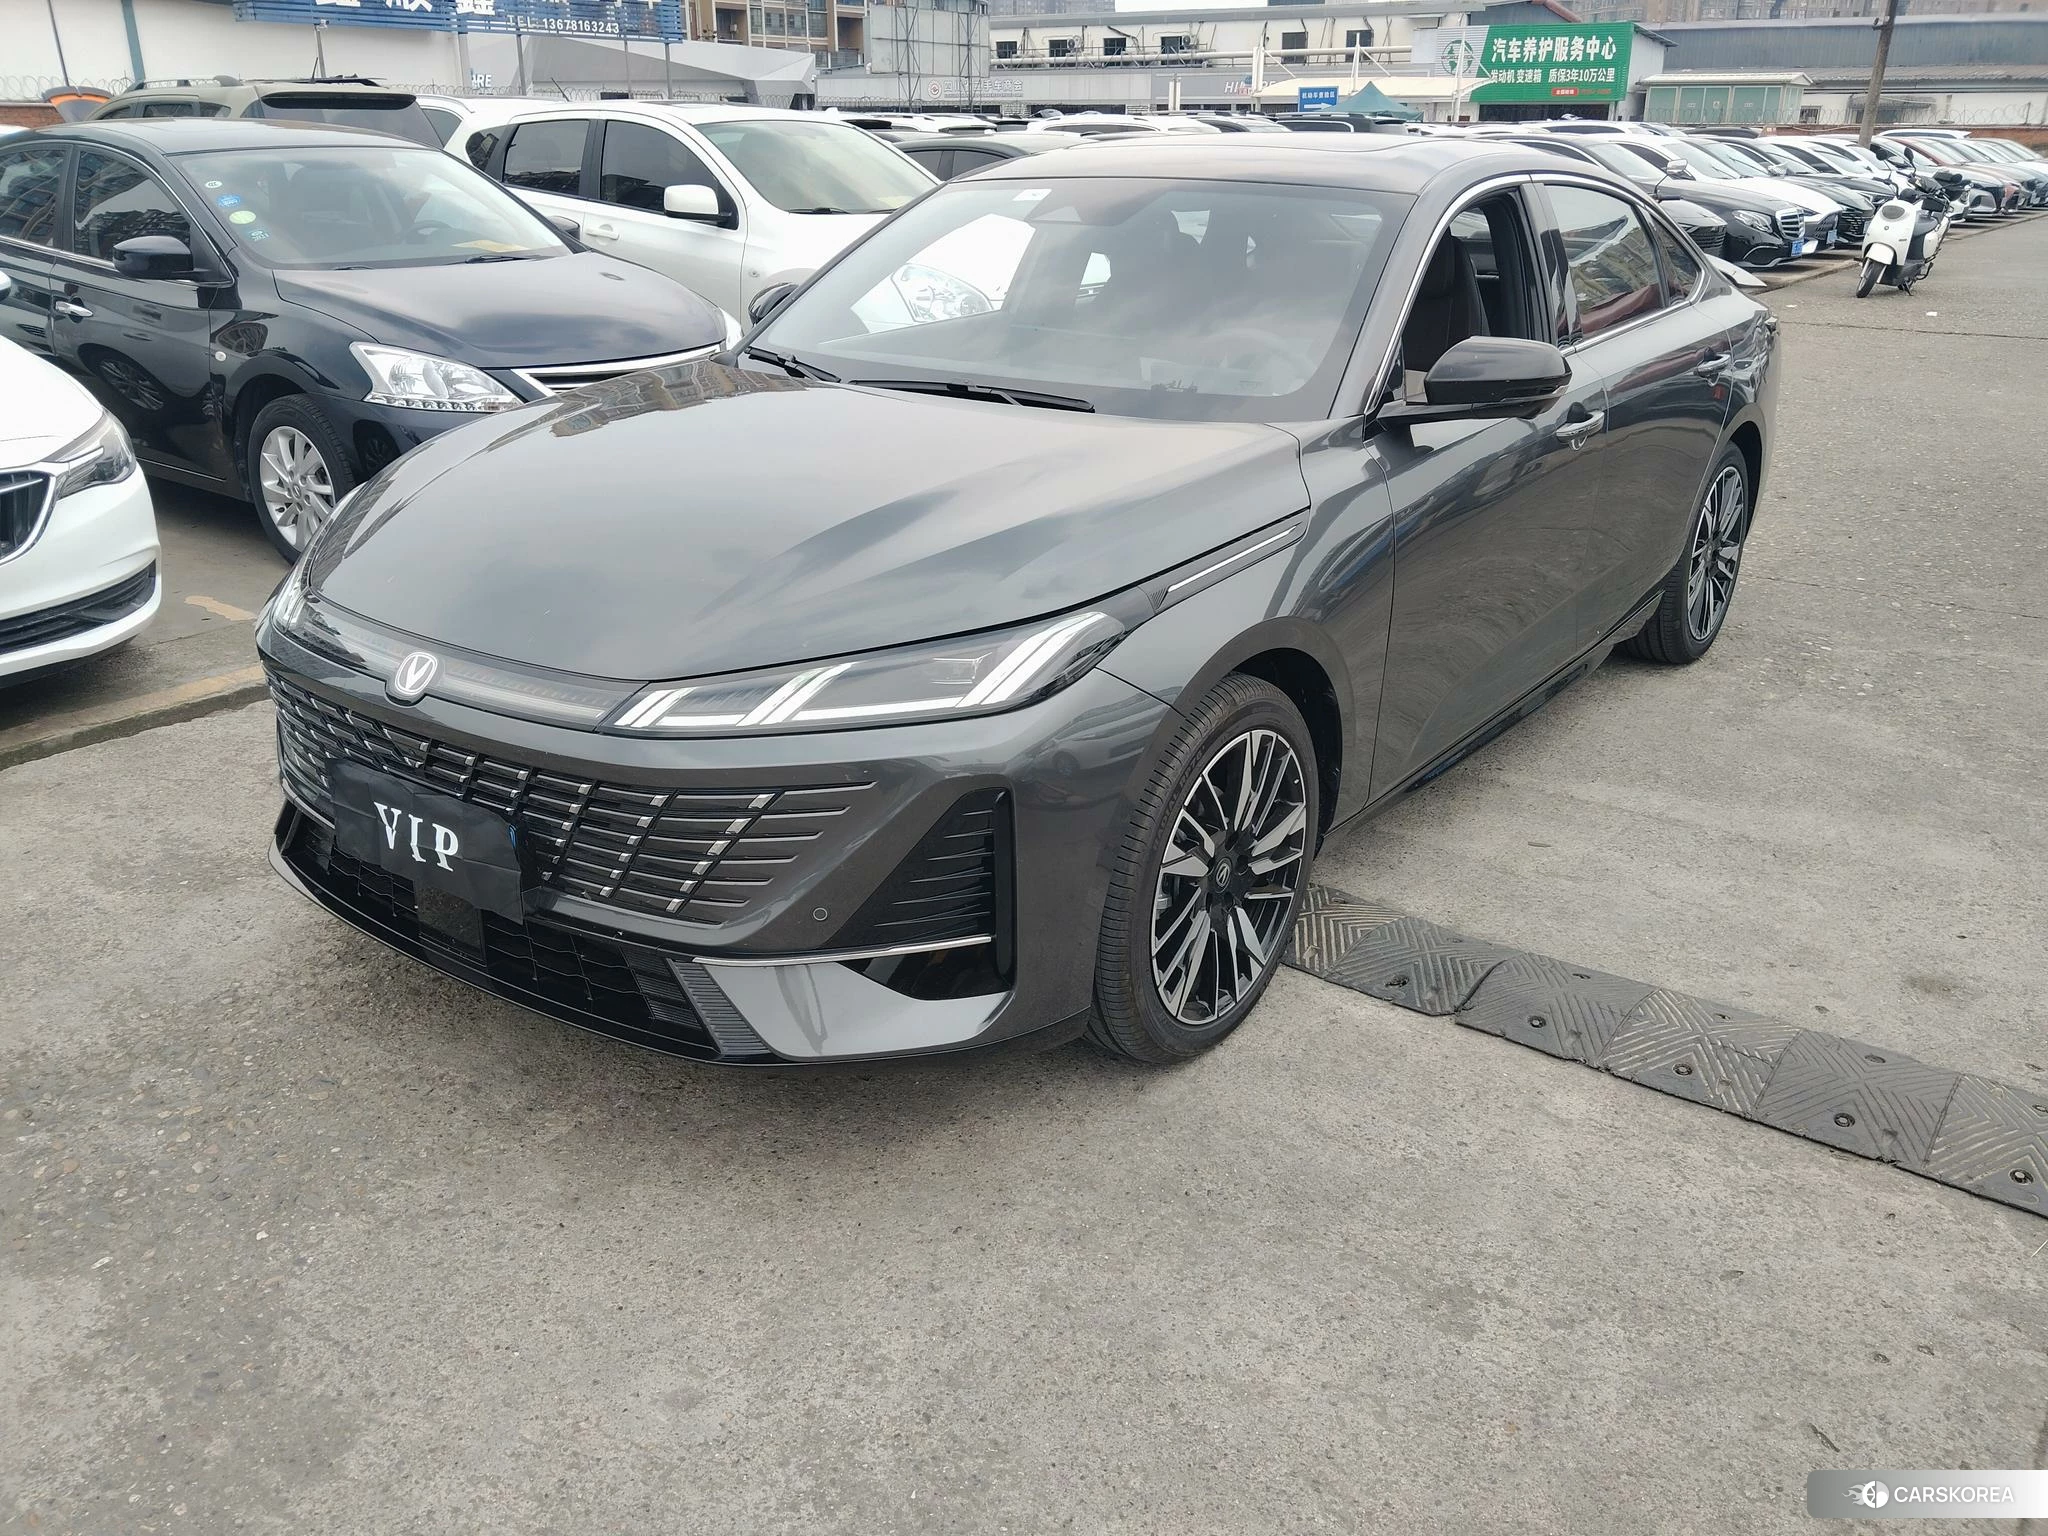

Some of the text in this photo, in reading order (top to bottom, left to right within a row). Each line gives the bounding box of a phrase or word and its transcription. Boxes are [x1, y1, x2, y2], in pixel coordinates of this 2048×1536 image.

[542, 18, 620, 34] 13678163243
[1492, 35, 1616, 62] 汽车养护服务中心
[1548, 68, 1615, 83] 质保3年10万公里
[373, 801, 459, 872] VIP
